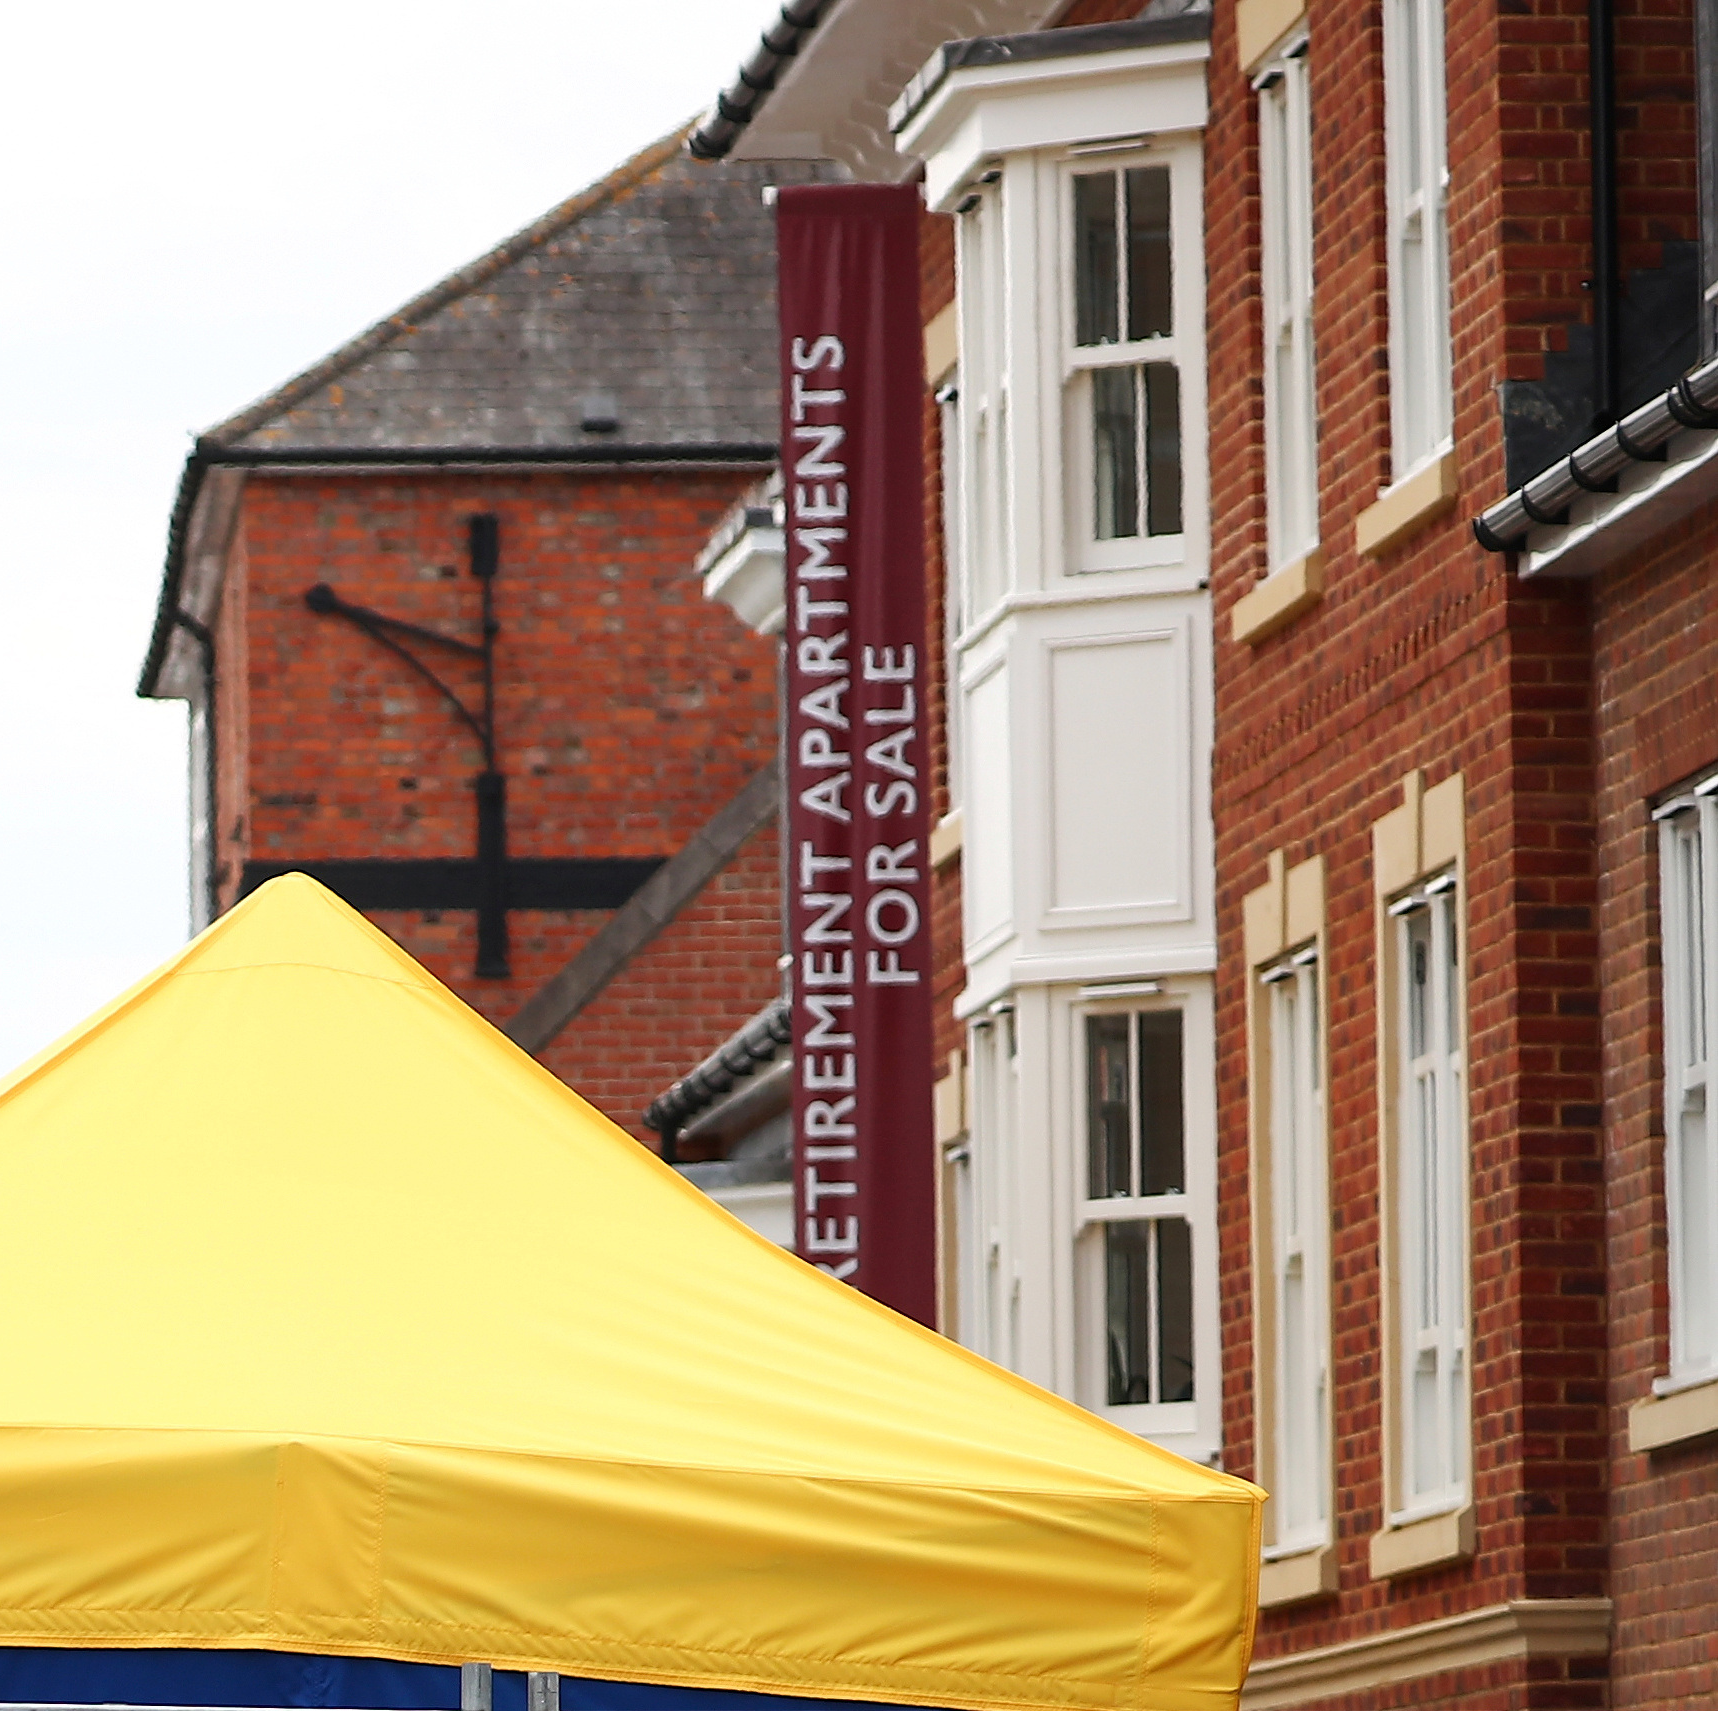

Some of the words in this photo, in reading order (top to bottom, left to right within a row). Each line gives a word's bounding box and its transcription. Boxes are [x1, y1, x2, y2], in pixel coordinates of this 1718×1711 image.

[791, 334, 851, 823] APARTMENTS
[861, 643, 917, 819] SALE
[865, 838, 920, 985] FOR
